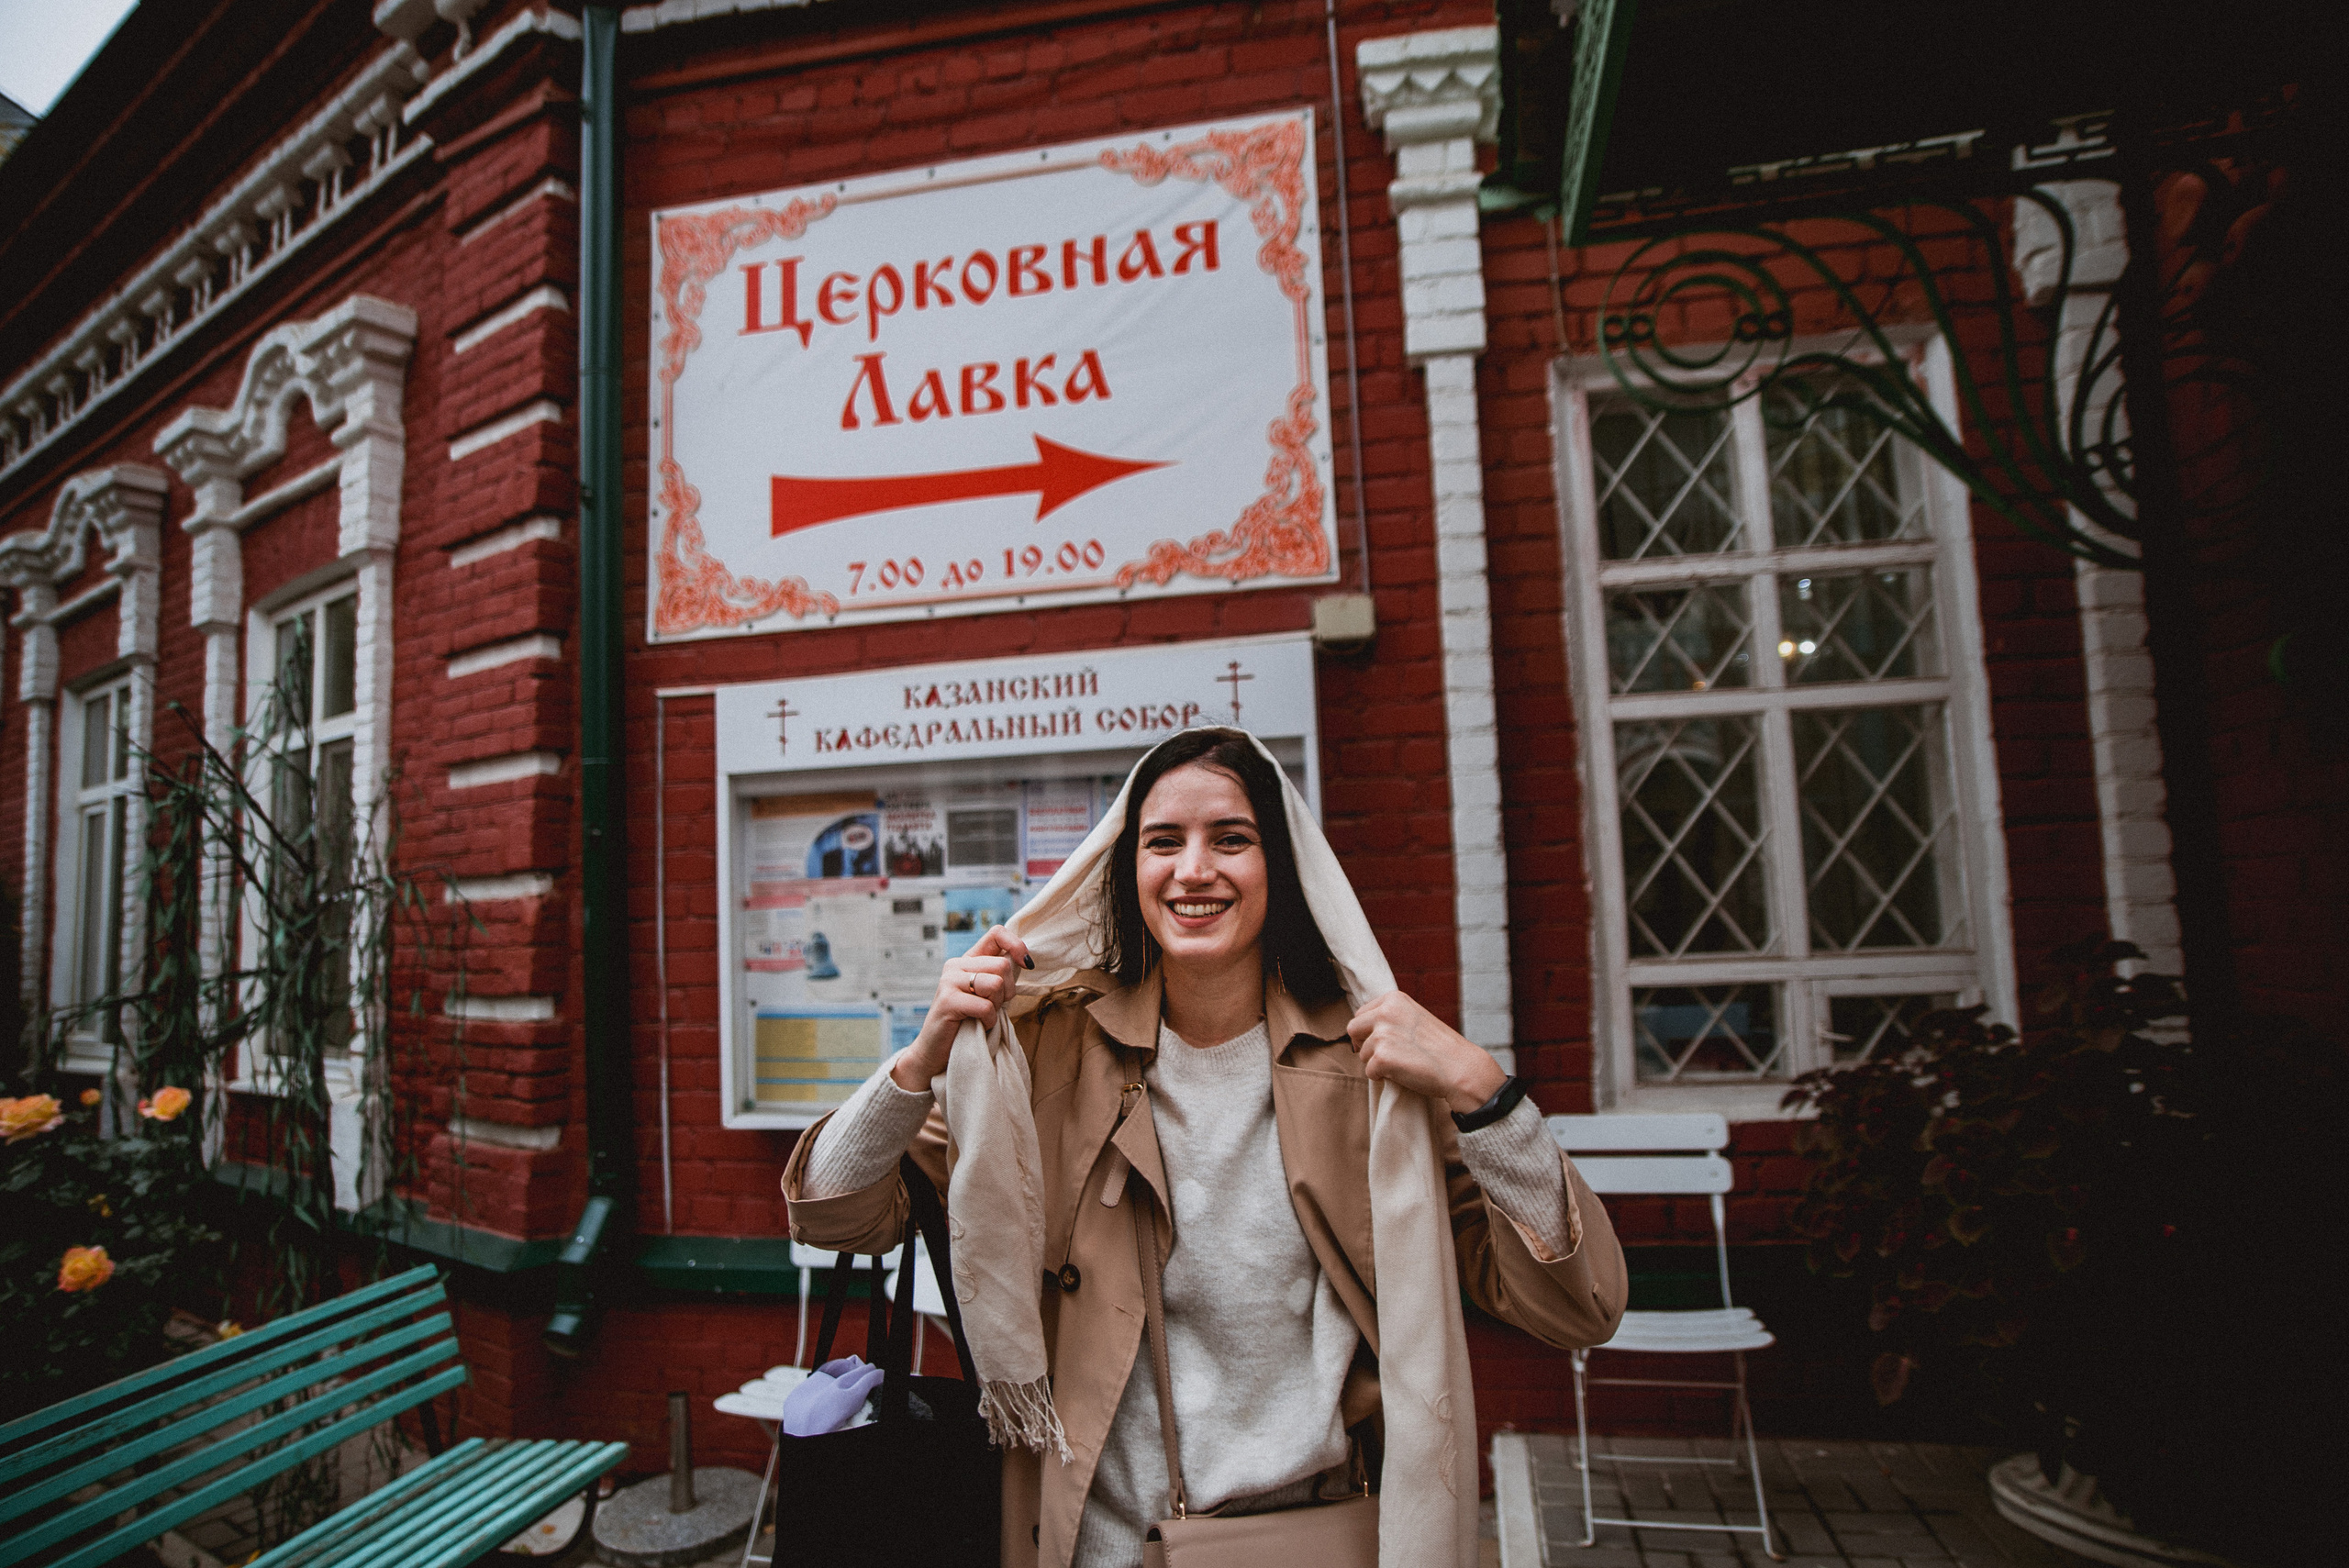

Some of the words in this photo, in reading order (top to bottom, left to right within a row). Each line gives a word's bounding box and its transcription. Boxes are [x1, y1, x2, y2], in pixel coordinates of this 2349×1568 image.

[739, 218, 1221, 350] Церковная
[841, 349, 1112, 431] Лавка
[847, 555, 925, 595] 7.00
[940, 557, 984, 592] до
[1002, 538, 1106, 579] 19.00
[904, 667, 1099, 710] КАЗАНСКИЙ
[814, 706, 1083, 754] КАФЕДРАЛЬНЫЙ
[1096, 702, 1200, 733] СОБОР
